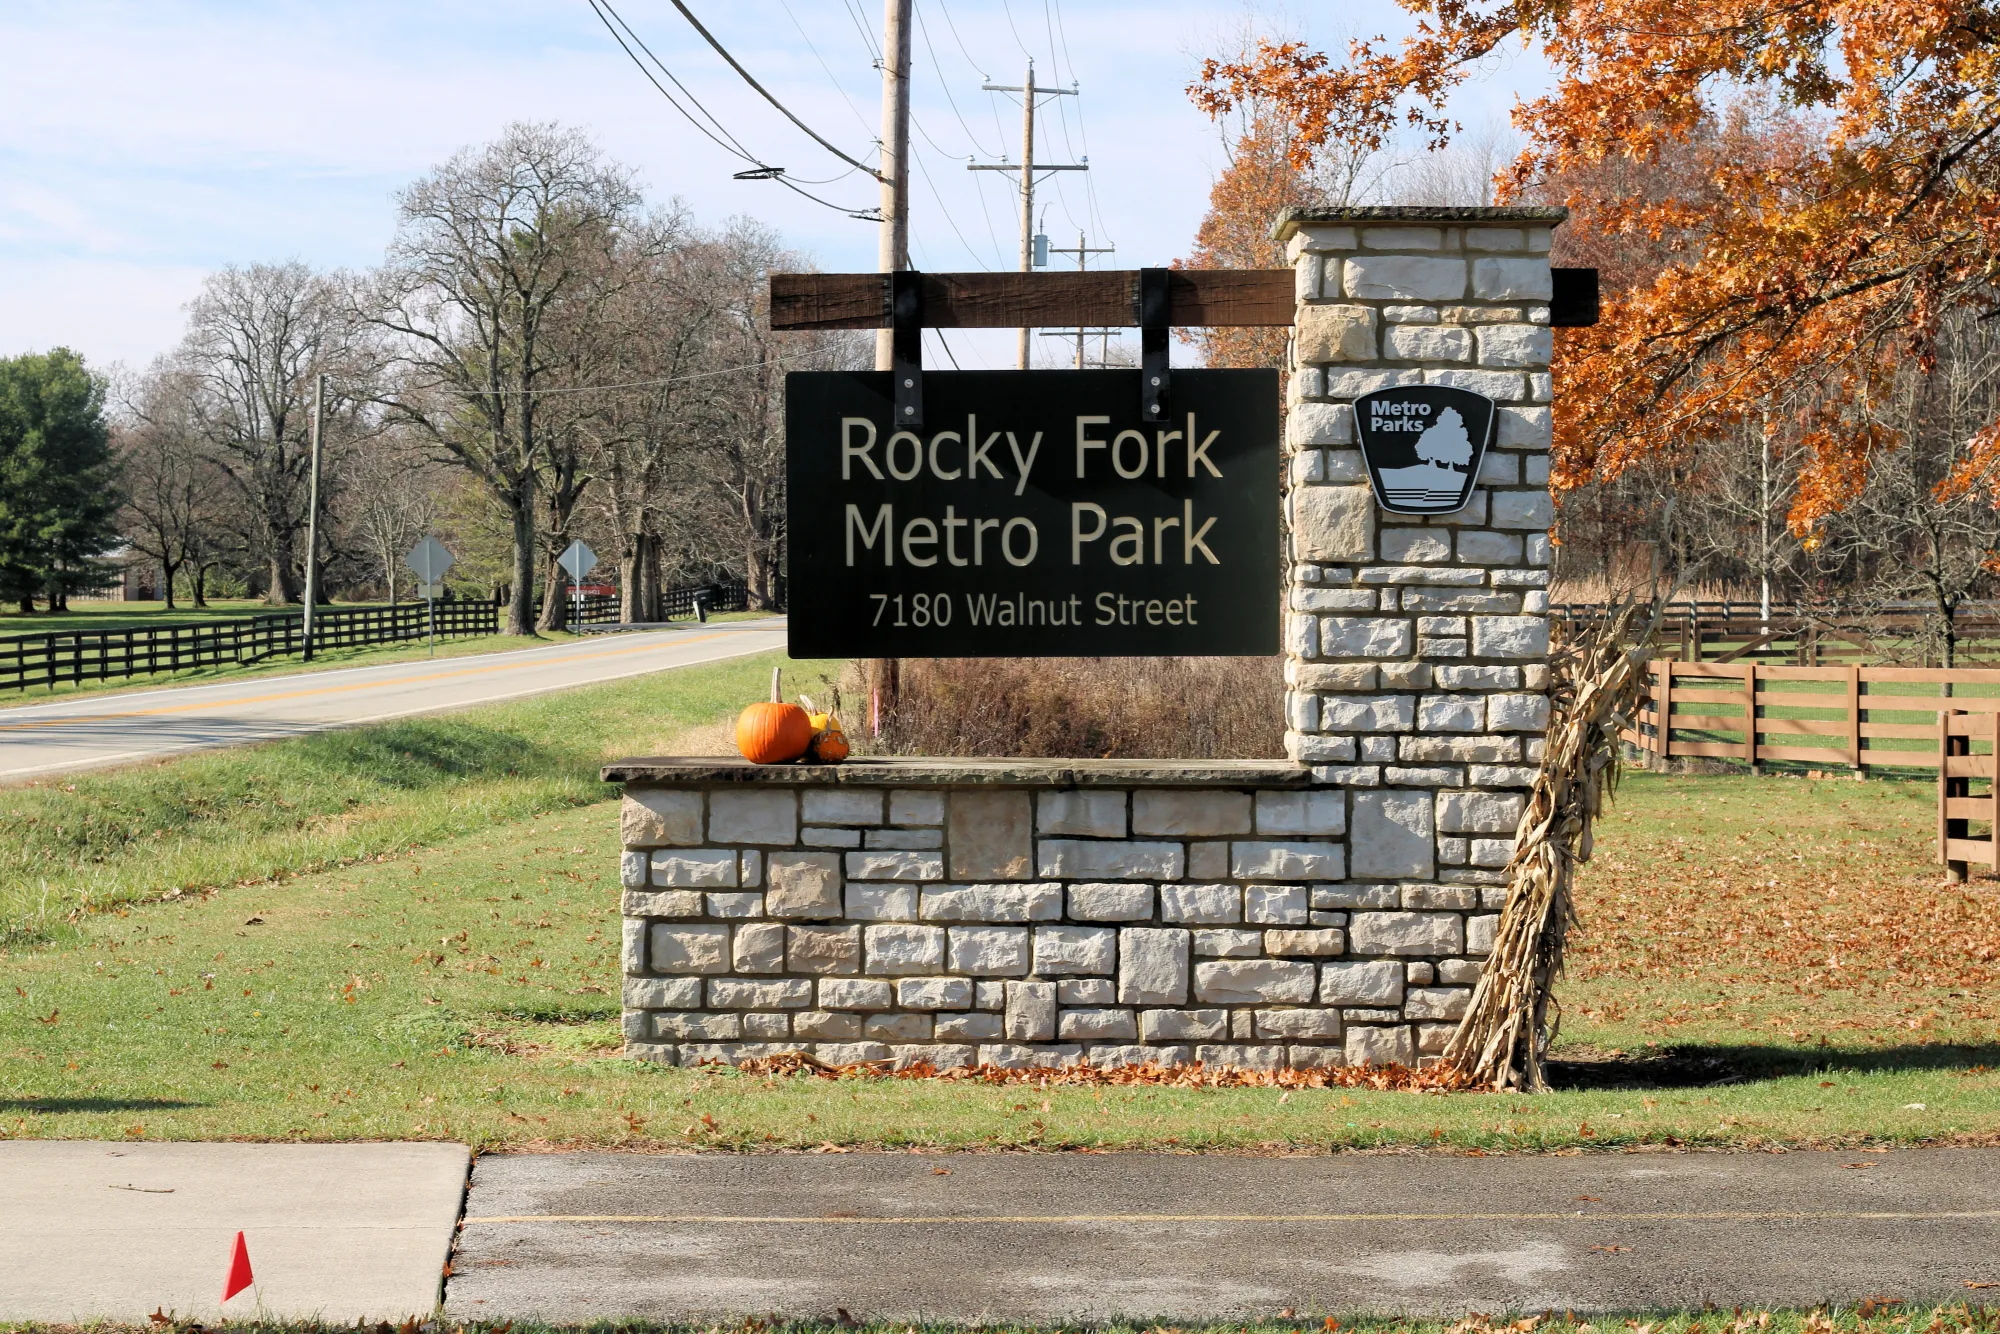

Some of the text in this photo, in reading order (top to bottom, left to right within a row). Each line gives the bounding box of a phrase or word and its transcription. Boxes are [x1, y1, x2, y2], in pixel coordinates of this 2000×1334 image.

[1371, 400, 1431, 415] Metro
[1371, 416, 1424, 432] Parks
[841, 411, 1223, 496] Rocky Fork
[845, 499, 1221, 567] Metro Park
[869, 593, 1198, 626] 7180 Walnut Street
